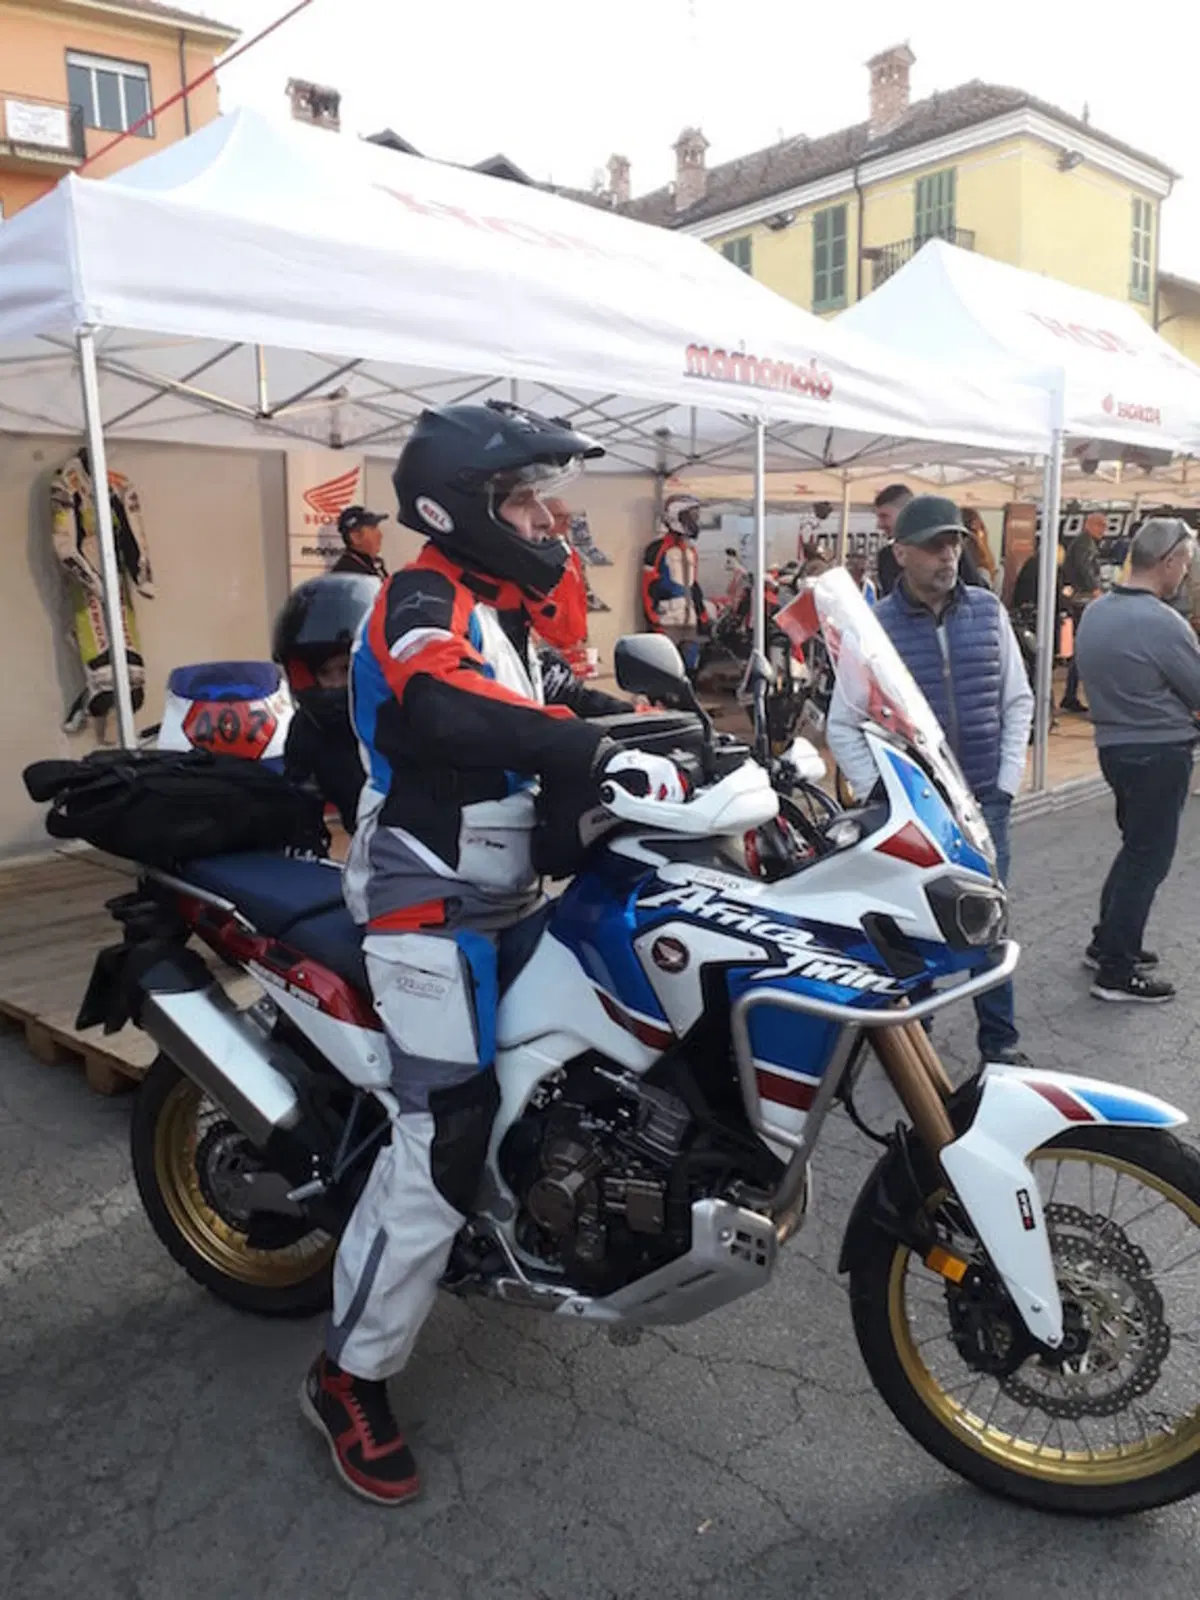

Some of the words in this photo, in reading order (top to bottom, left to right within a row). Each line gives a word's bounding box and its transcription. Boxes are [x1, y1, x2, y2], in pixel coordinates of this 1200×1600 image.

[421, 503, 447, 529] BELL
[637, 880, 842, 946] Africa
[751, 941, 907, 995] Twin
